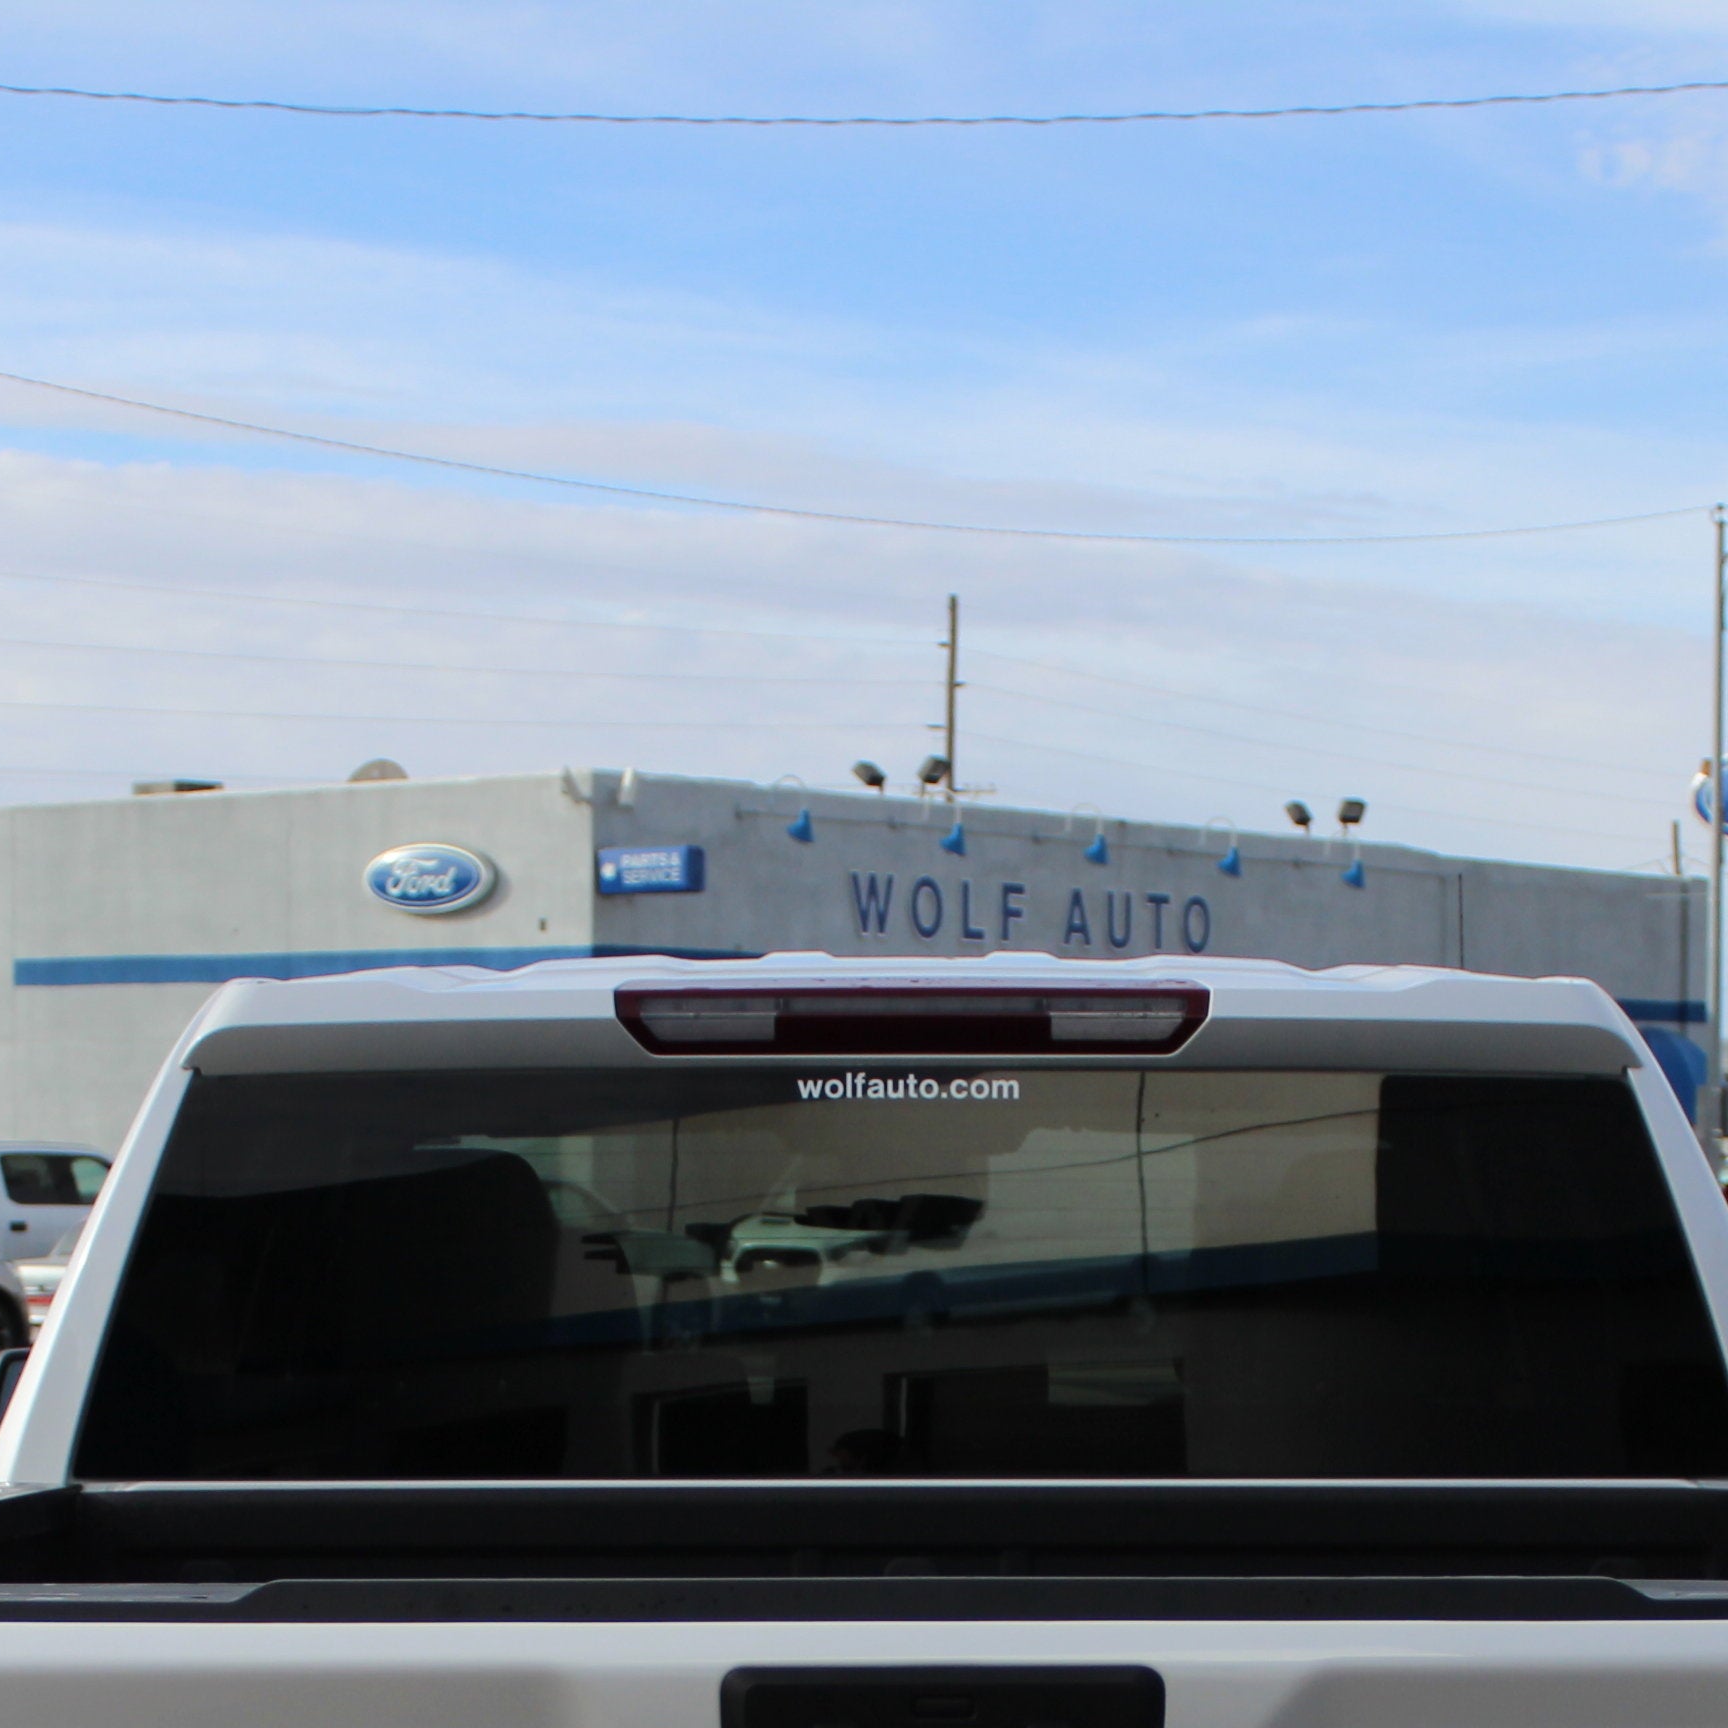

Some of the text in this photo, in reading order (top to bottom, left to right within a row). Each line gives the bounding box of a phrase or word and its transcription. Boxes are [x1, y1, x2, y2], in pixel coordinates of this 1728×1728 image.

[386, 857, 457, 897] Ford
[851, 871, 1211, 953] WOLF AUTO
[797, 1072, 1020, 1099] wolfauto.com
